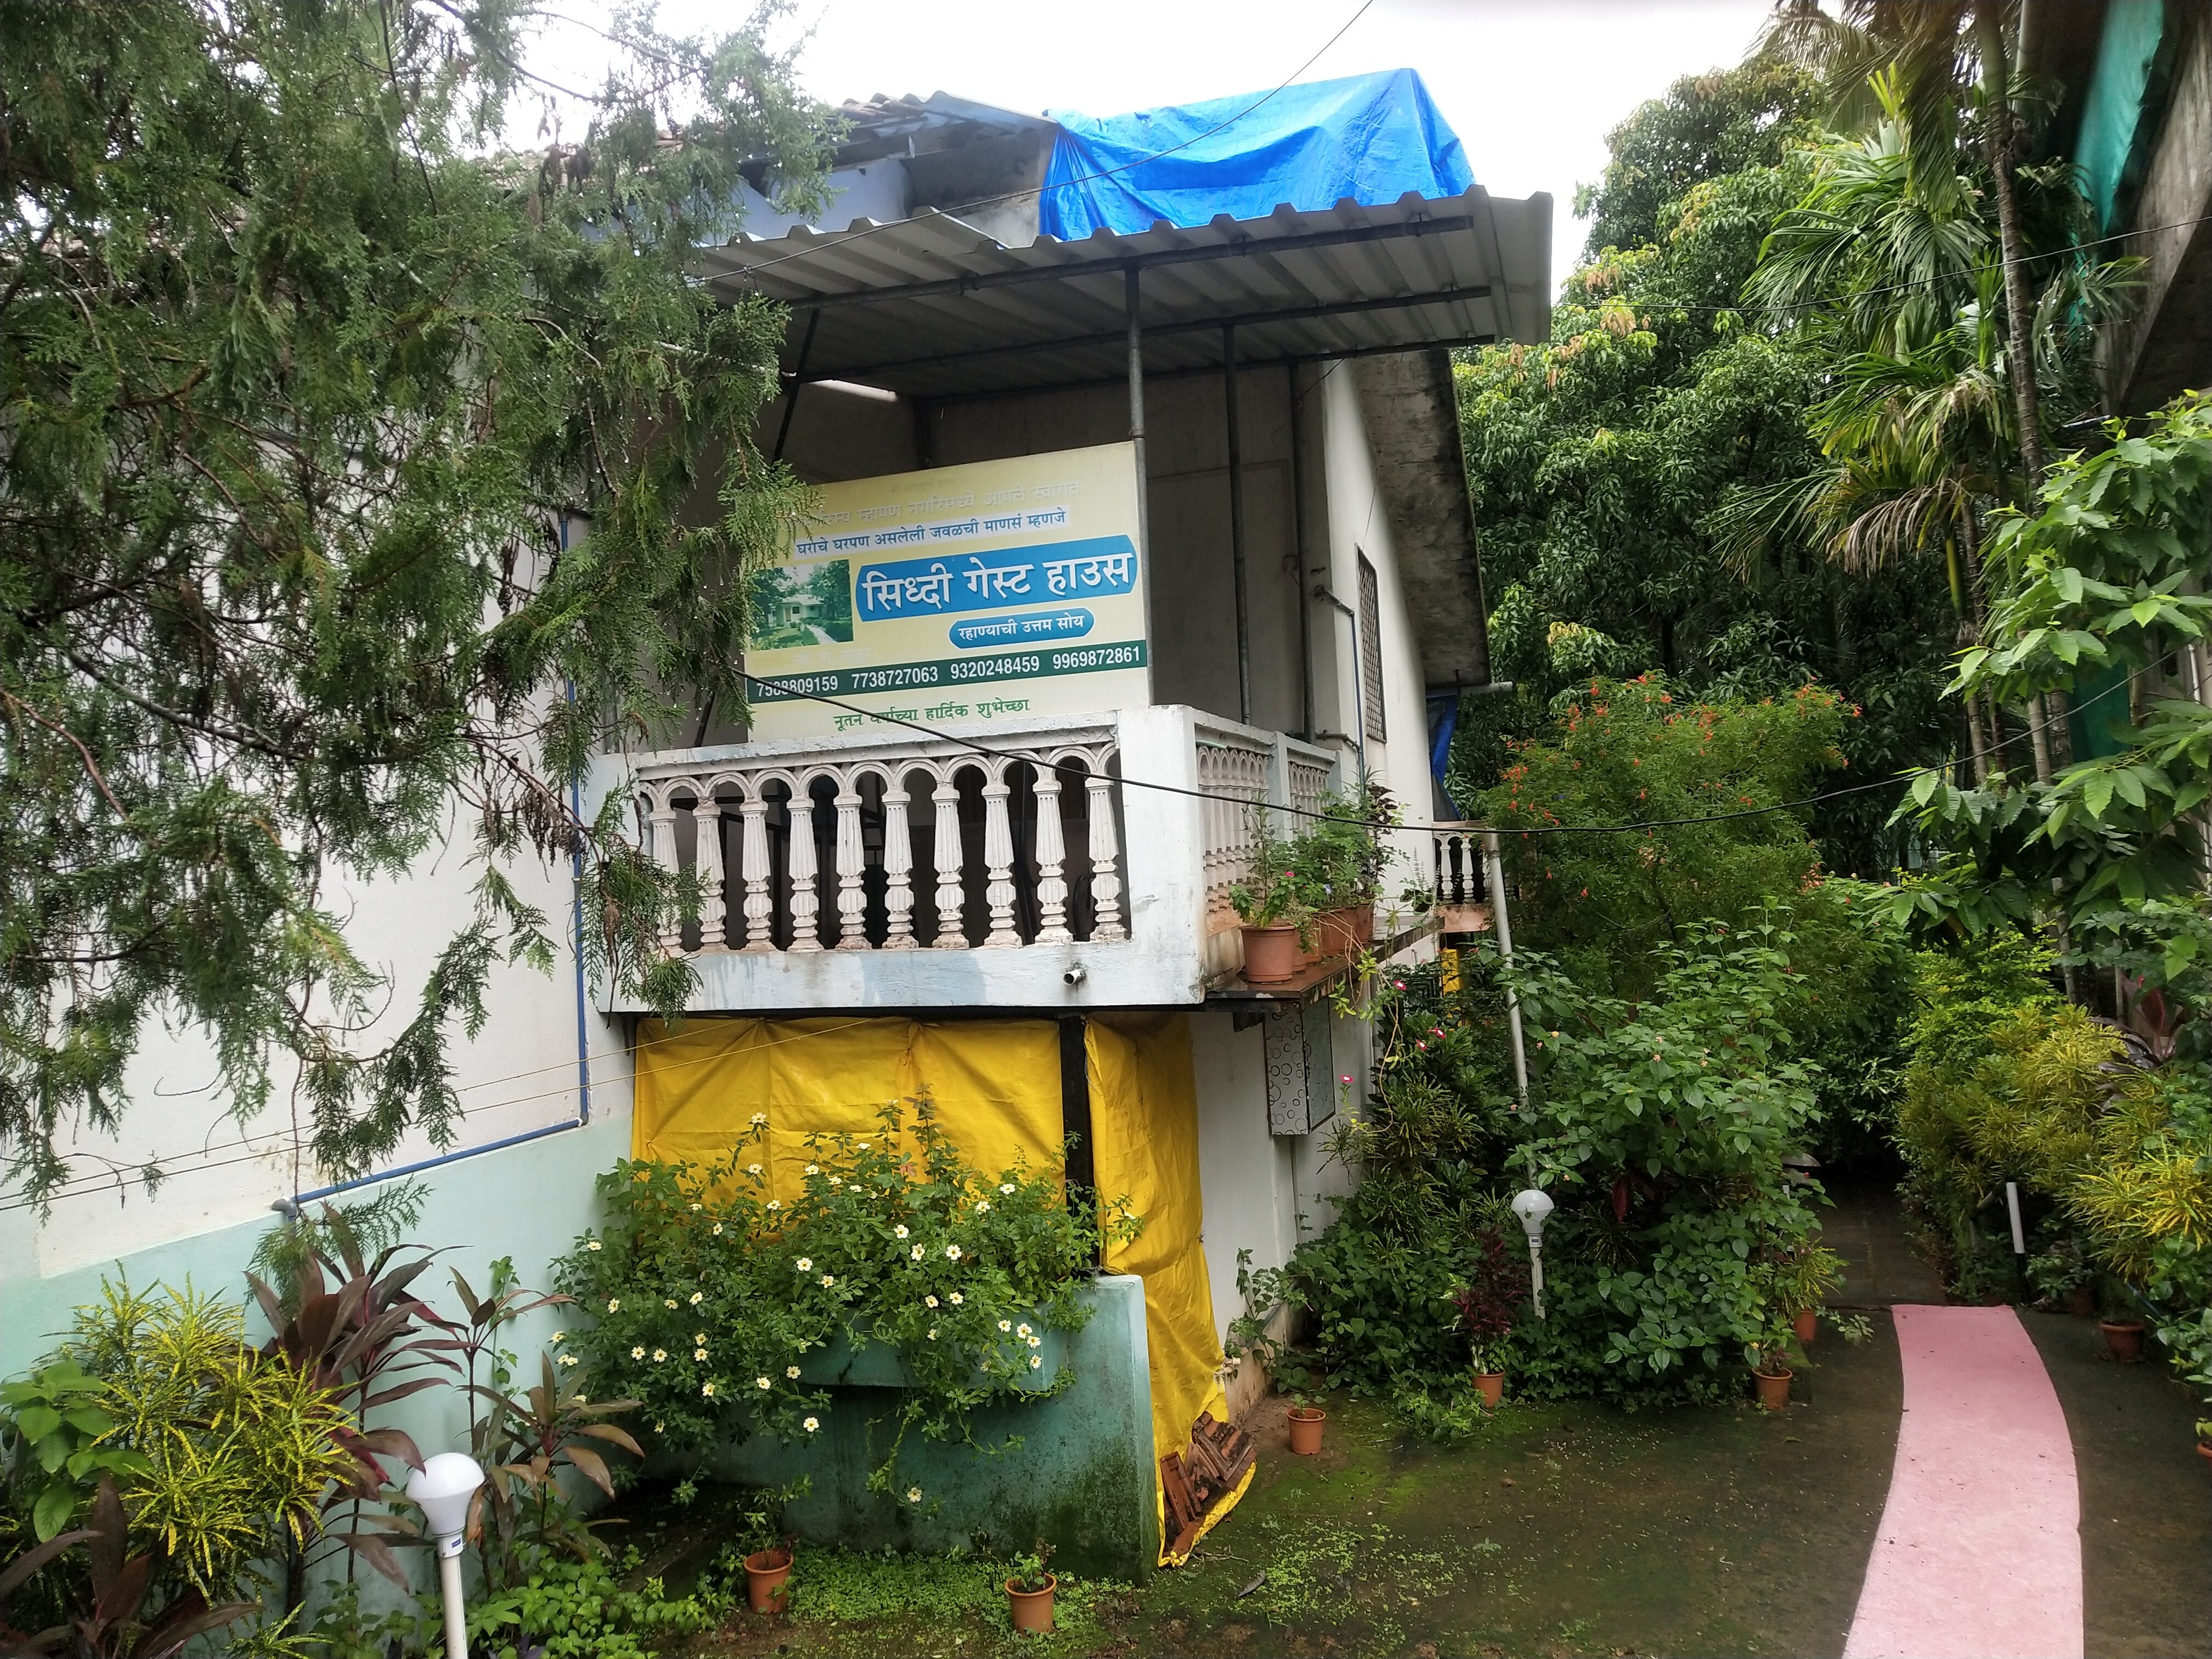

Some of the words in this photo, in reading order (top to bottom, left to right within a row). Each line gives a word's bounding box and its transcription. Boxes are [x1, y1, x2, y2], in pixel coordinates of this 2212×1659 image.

[984, 484, 1025, 507] आपले
[1032, 481, 1081, 502] स्वागत
[833, 535, 869, 552] घरपण
[874, 524, 925, 548] असलेली
[930, 518, 980, 540] जवळची
[984, 513, 1022, 534] माणसं
[1027, 507, 1066, 526] म्हणजे
[862, 562, 953, 612] सिध्दी
[963, 557, 1034, 600] गेस्ट
[1042, 552, 1133, 594] हाउस
[958, 619, 1017, 641] रहाण्याची
[1022, 617, 1052, 634] उत्तम
[1056, 612, 1084, 630] सोय
[851, 666, 939, 689] 7738727063
[950, 655, 1040, 679] 9320248459
[1053, 646, 1140, 670] 9969872861
[833, 714, 865, 732] नूतन
[926, 700, 969, 720] हार्दिक
[977, 697, 1030, 719] शुभेच्छा
